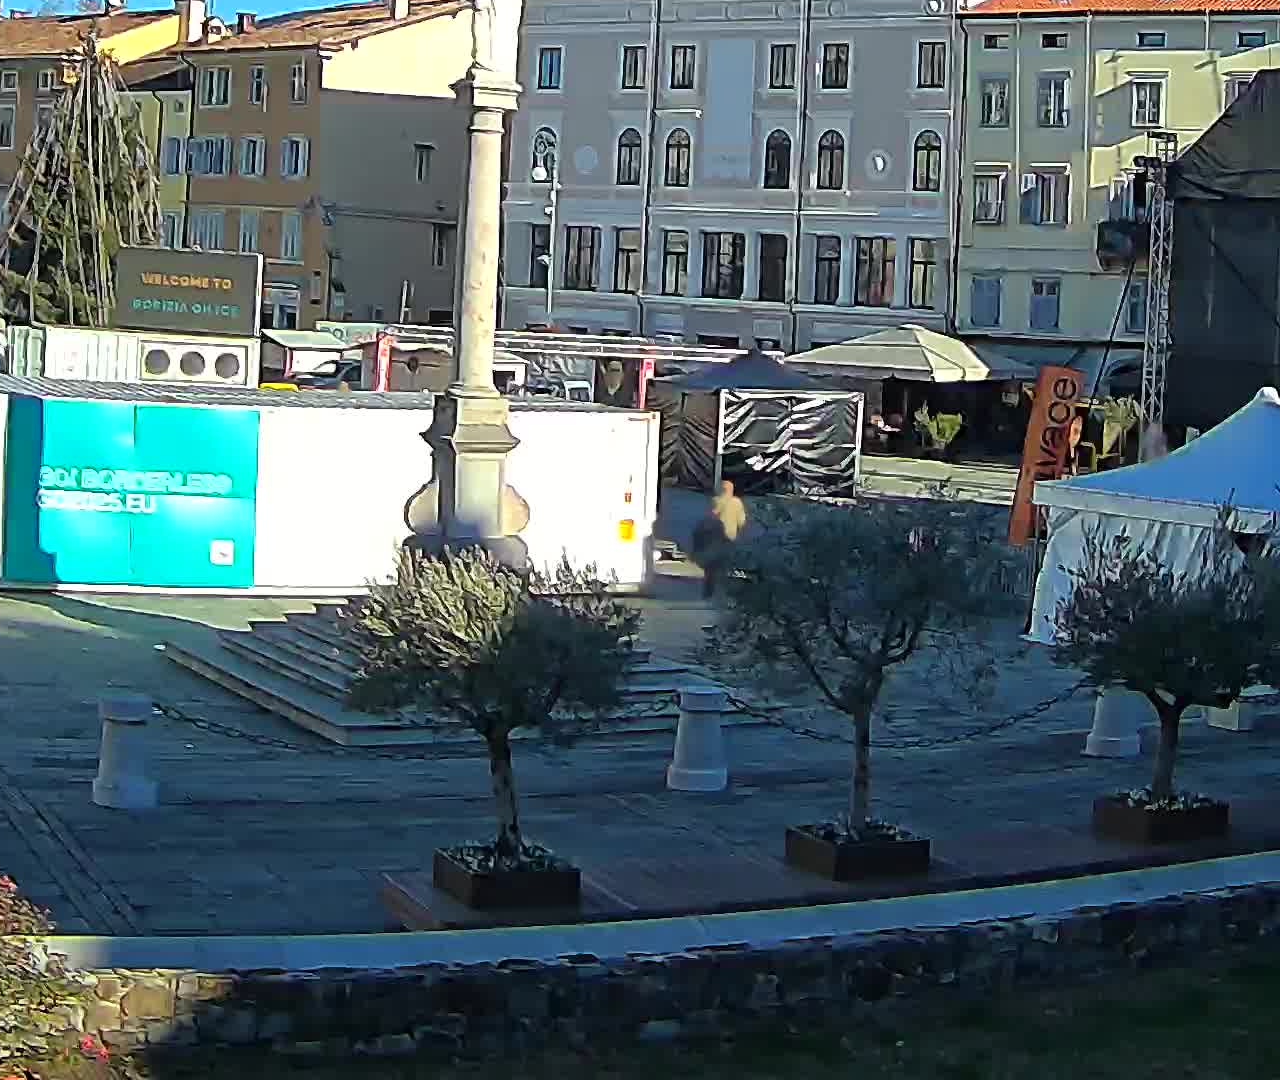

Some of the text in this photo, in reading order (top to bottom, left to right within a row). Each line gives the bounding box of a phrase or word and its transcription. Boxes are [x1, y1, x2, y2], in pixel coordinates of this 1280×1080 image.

[141, 272, 233, 290] WELCOME TO
[1025, 376, 1077, 483] ivace
